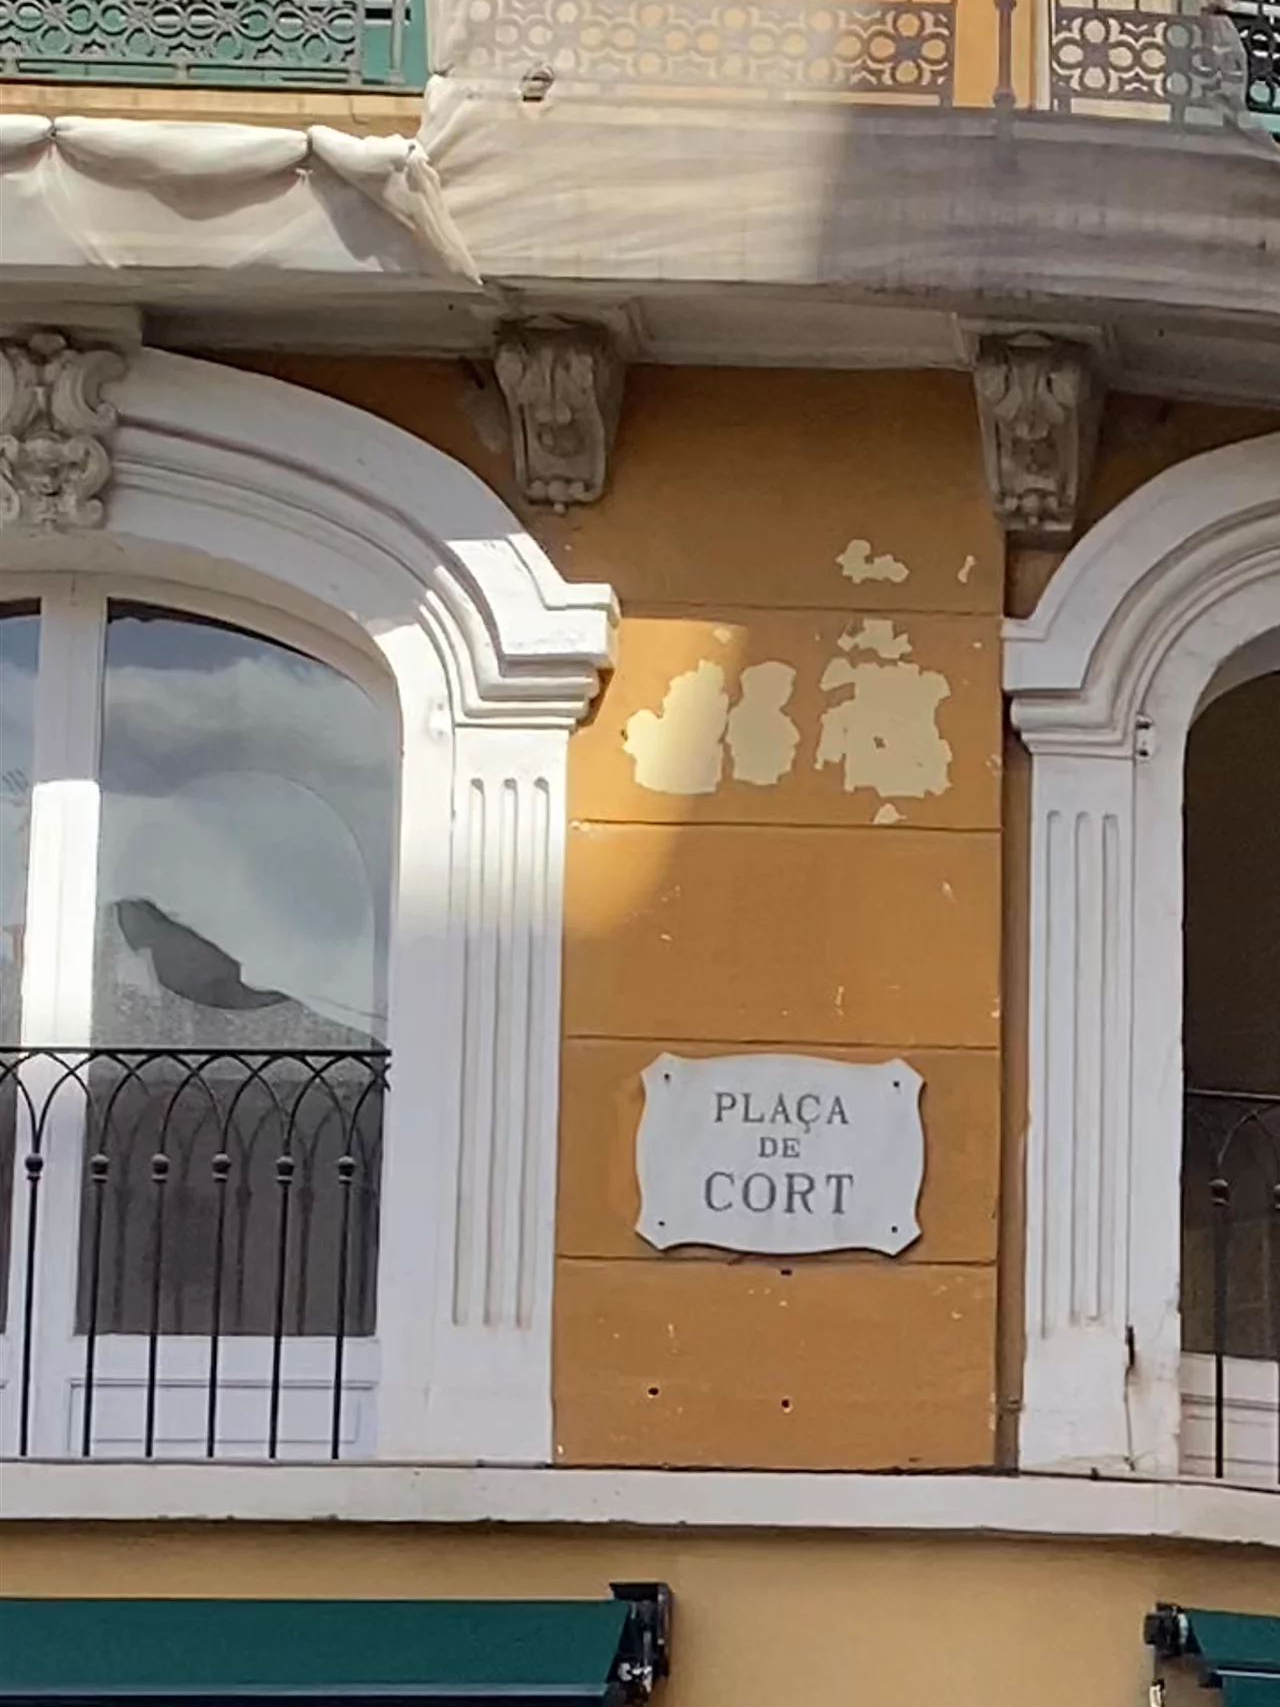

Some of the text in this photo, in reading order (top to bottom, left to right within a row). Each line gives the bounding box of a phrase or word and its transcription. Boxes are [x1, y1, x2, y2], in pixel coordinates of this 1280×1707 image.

[713, 1092, 850, 1133] PLAÇA
[758, 1137, 800, 1159] DE
[703, 1171, 854, 1215] CORT
